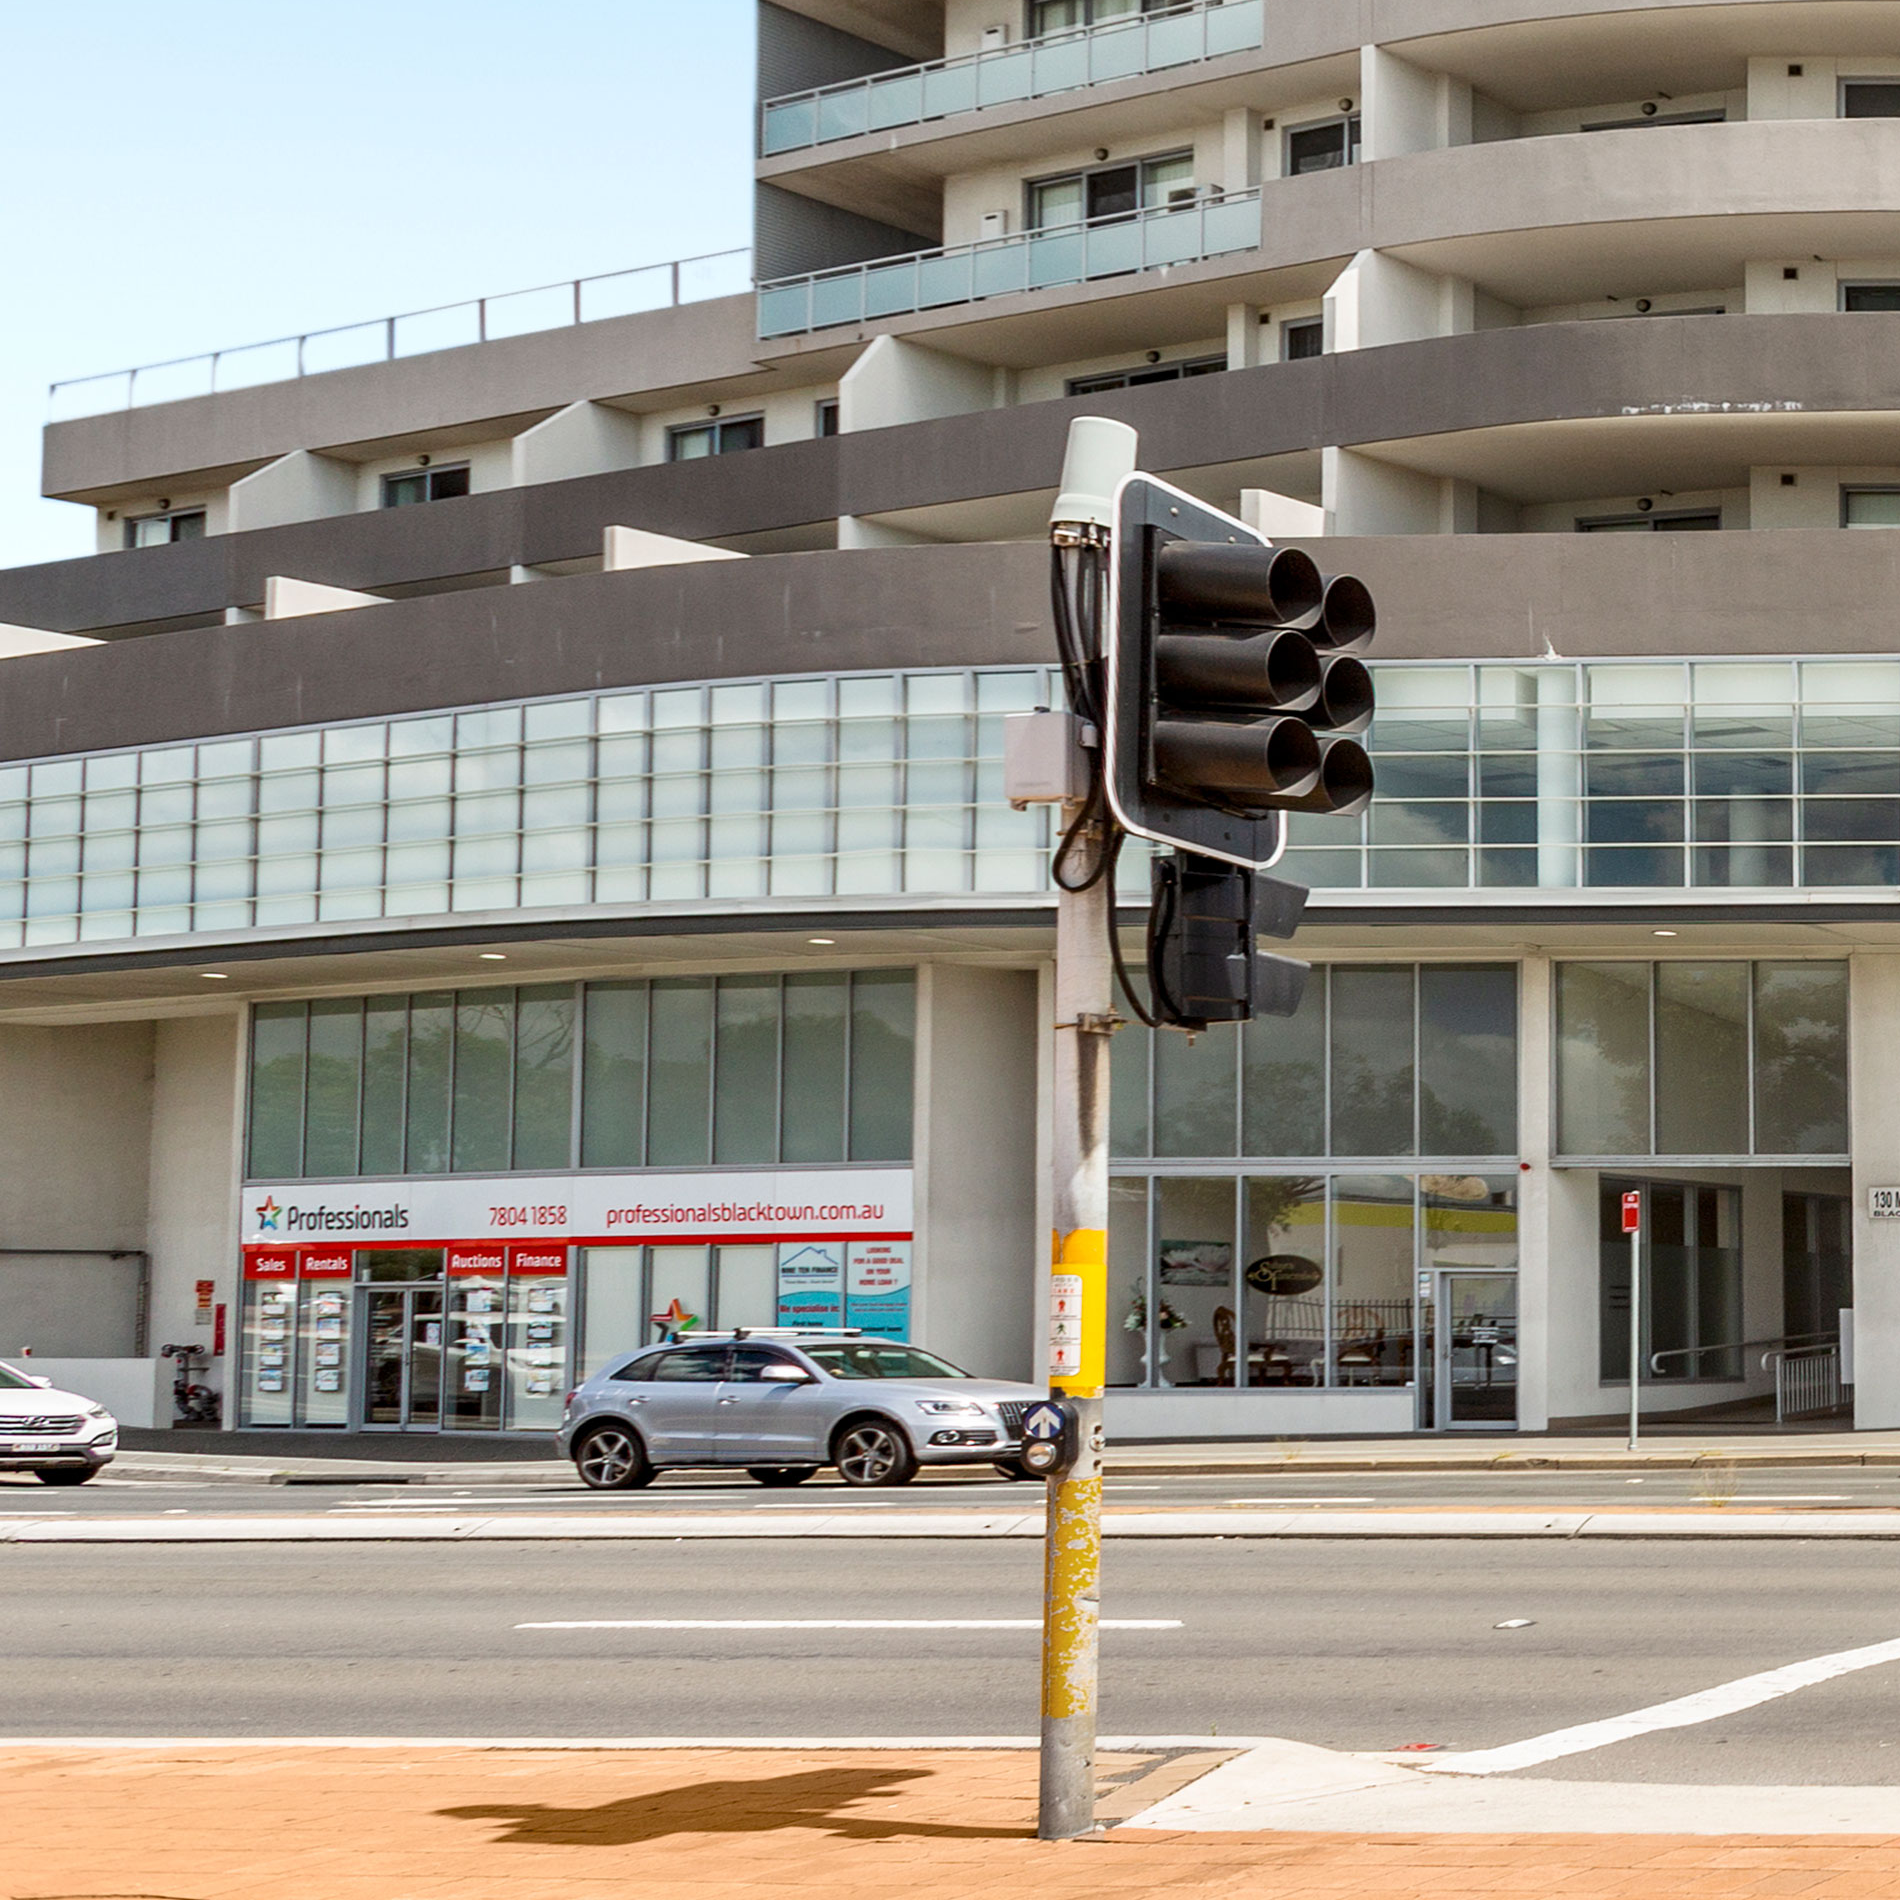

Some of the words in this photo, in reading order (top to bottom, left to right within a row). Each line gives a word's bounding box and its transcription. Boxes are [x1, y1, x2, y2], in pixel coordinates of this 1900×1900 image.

[1874, 1191, 1892, 1208] 130
[287, 1203, 409, 1231] Professionals
[489, 1206, 527, 1226] 7804
[531, 1205, 567, 1225] 1858
[606, 1202, 884, 1228] professionalsblacktown.com.au
[256, 1257, 286, 1272] Sales
[305, 1256, 348, 1271] Rentals
[452, 1254, 502, 1269] Auctions
[516, 1252, 562, 1267] Finance
